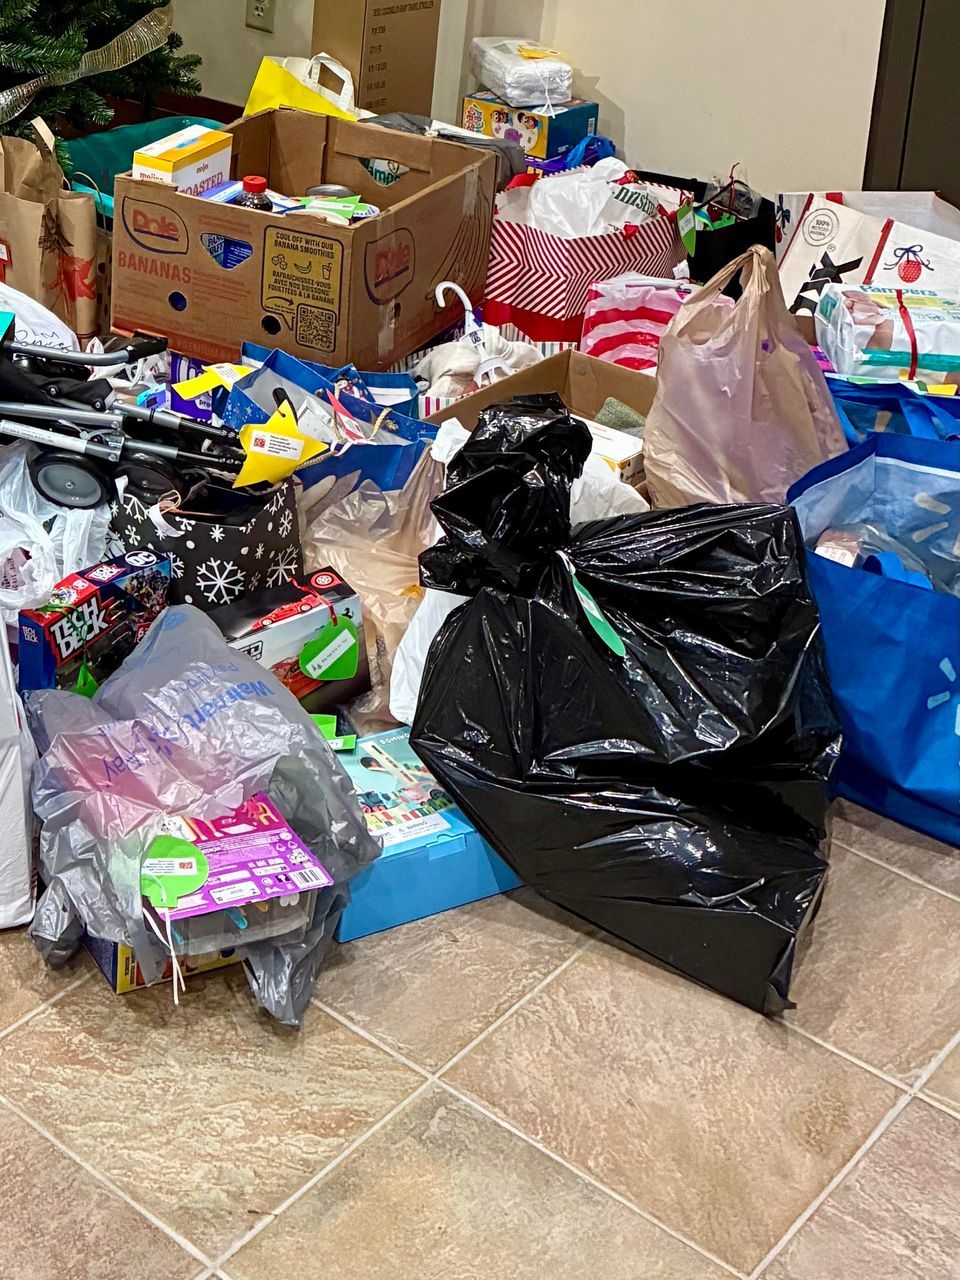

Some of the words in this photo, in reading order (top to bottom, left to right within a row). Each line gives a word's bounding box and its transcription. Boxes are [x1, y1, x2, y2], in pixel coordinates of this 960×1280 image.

[180, 171, 224, 197] OASTED
[132, 209, 180, 237] Dole
[274, 239, 299, 252] BANANA
[300, 245, 335, 259] SMOOTHIES
[276, 231, 291, 242] COOL
[292, 234, 303, 244] OFF
[305, 236, 320, 247] WITH
[321, 241, 334, 251] OUR
[117, 250, 191, 284] BANANAS
[859, 285, 939, 297] Pampers
[125, 550, 156, 567] DC
[50, 597, 100, 644] TECH
[57, 607, 109, 659] DECK
